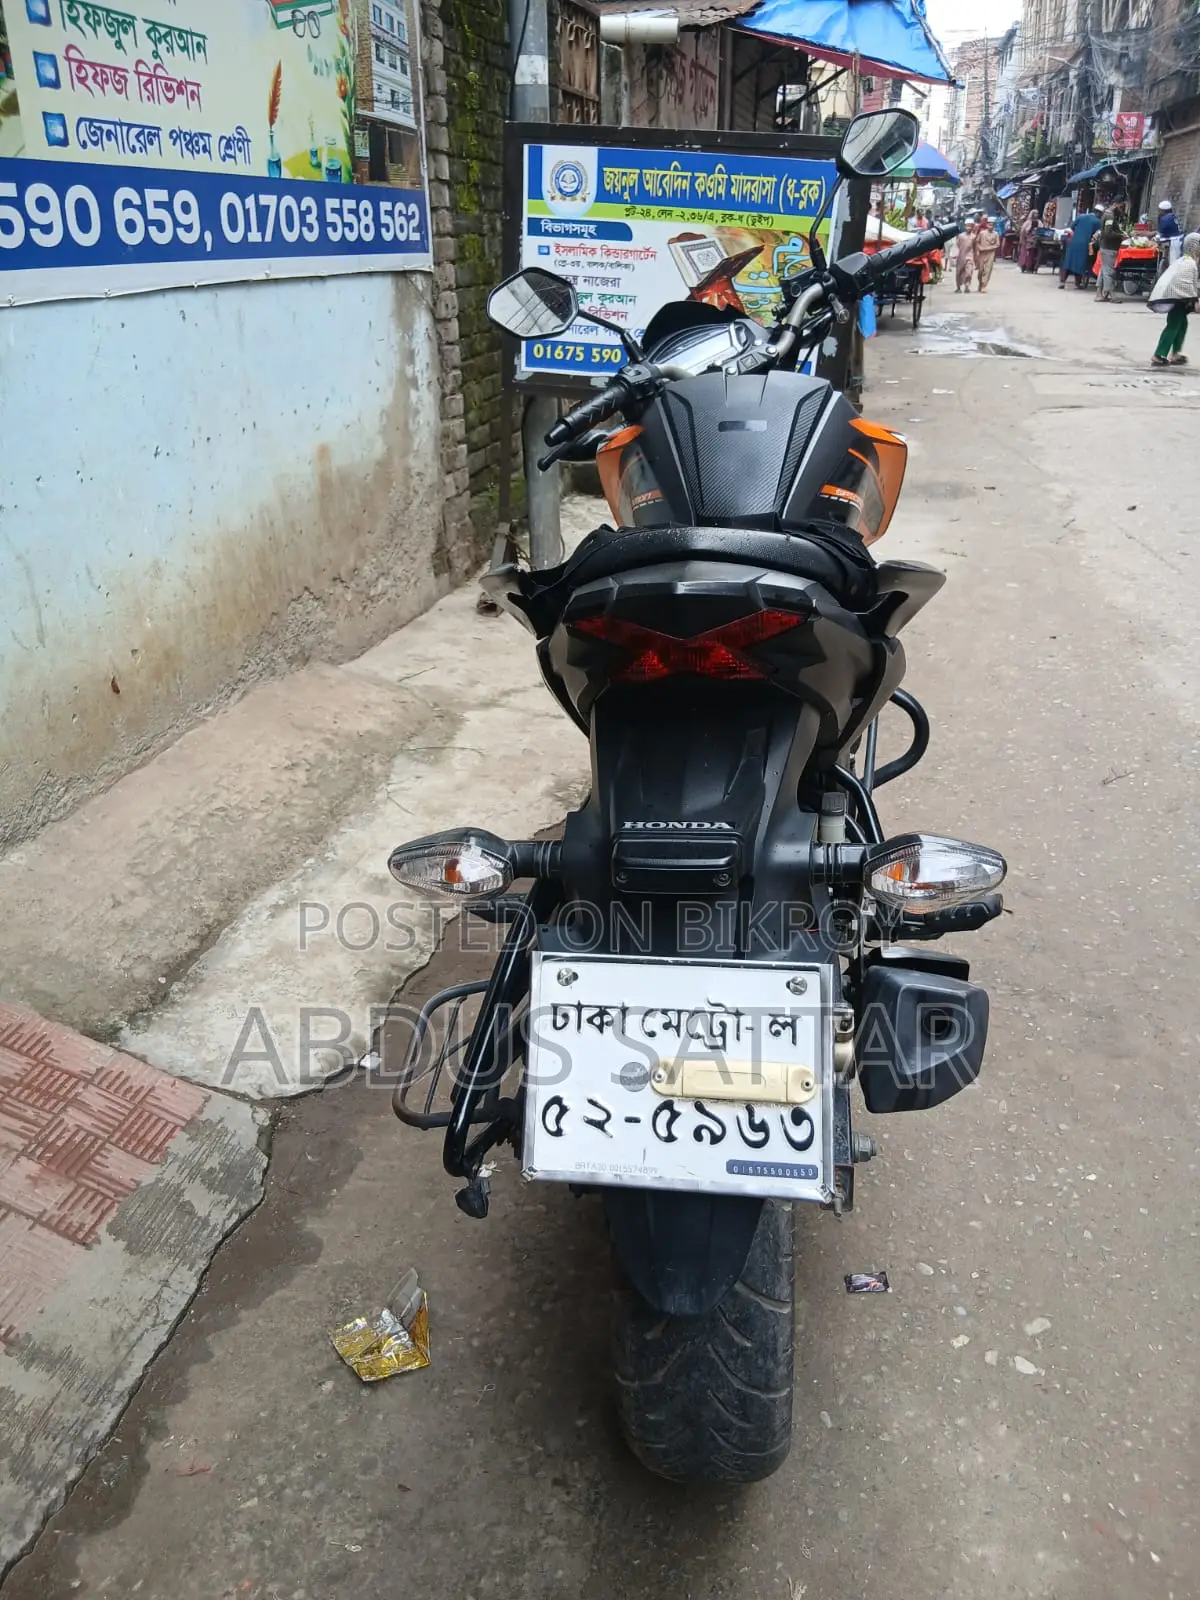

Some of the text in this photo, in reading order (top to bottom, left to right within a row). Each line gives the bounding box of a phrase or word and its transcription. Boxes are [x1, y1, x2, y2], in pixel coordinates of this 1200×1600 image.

[141, 17, 208, 64] কুরআন
[64, 43, 202, 112] হিফজ রিভিশন
[75, 116, 252, 166] জেনারেল পঞ্চম শ্রেণী
[642, 160, 692, 201] আবেদিন
[694, 163, 728, 201] কওমি
[730, 171, 778, 206] মাদরাসা
[0, 183, 421, 252] 590 659, 01703 558 562
[540, 219, 598, 238] বিভাগসমূহ
[553, 243, 598, 257] ইসলামিক
[582, 275, 622, 289] নাজেরা
[597, 292, 638, 307] কুরআন
[533, 343, 622, 363] 01675 590
[622, 821, 734, 829] HONDA
[550, 1000, 630, 1036] ঢাকা
